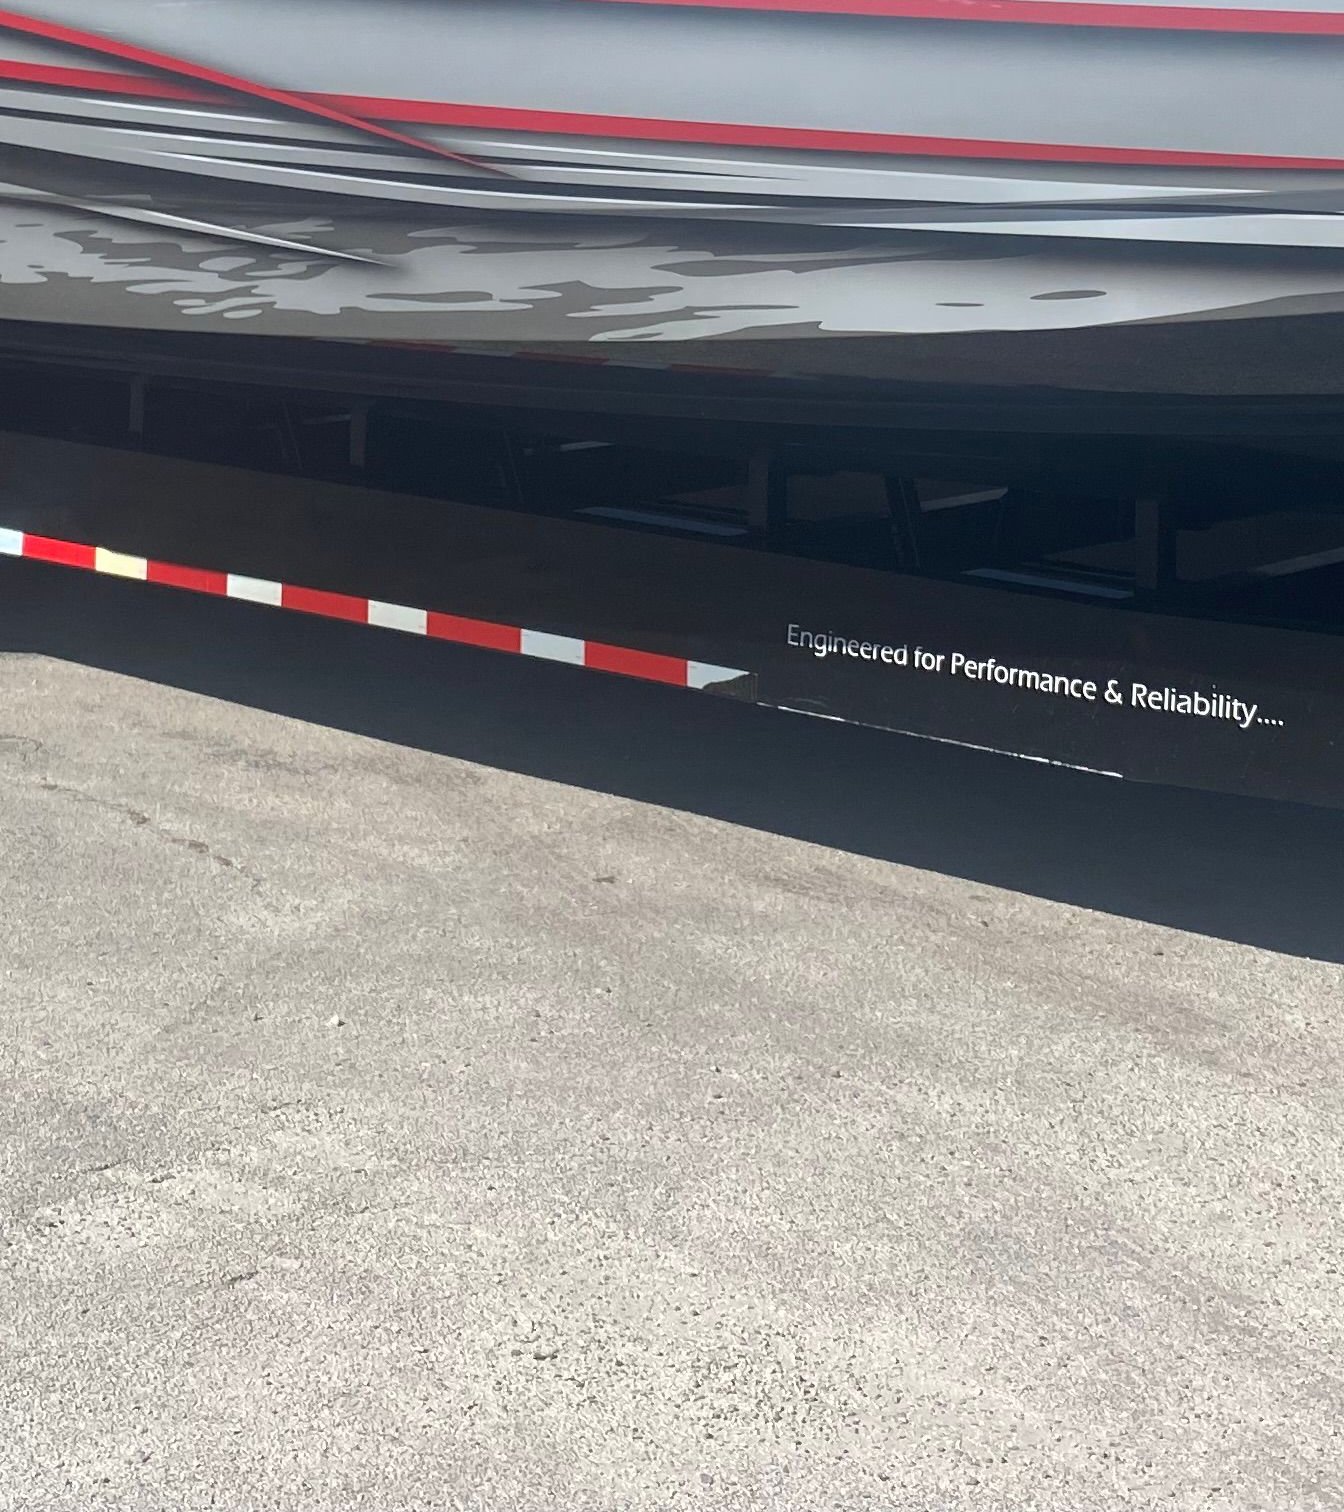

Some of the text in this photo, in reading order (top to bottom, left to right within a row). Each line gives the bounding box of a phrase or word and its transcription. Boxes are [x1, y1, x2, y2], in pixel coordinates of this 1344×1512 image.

[786, 623, 908, 667] Engineered
[913, 645, 946, 673] for
[950, 651, 1098, 702] Performance
[1103, 678, 1124, 706] &
